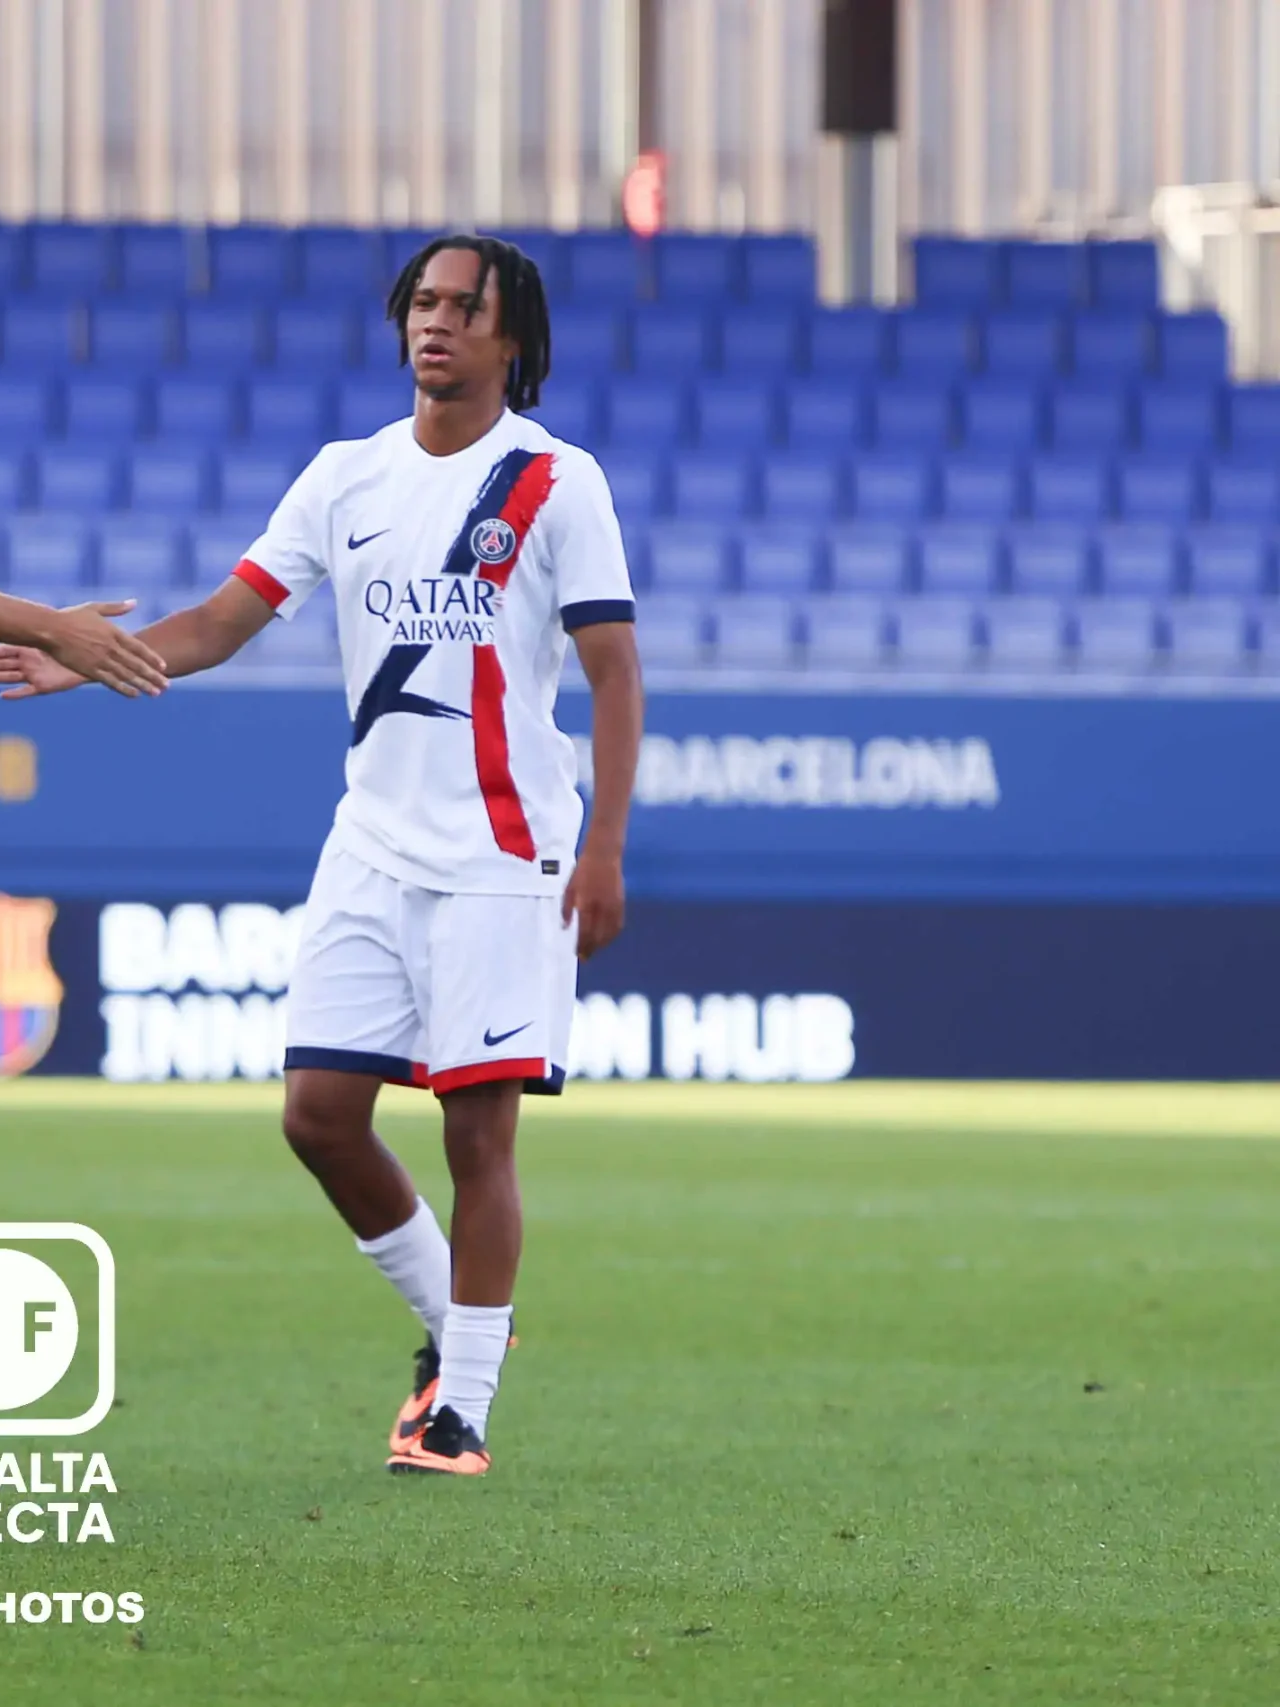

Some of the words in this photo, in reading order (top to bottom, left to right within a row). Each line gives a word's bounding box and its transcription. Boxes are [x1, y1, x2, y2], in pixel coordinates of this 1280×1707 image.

[365, 577, 496, 624] QATAR
[392, 619, 495, 643] AIRWAYS
[662, 992, 856, 1082] HUB
